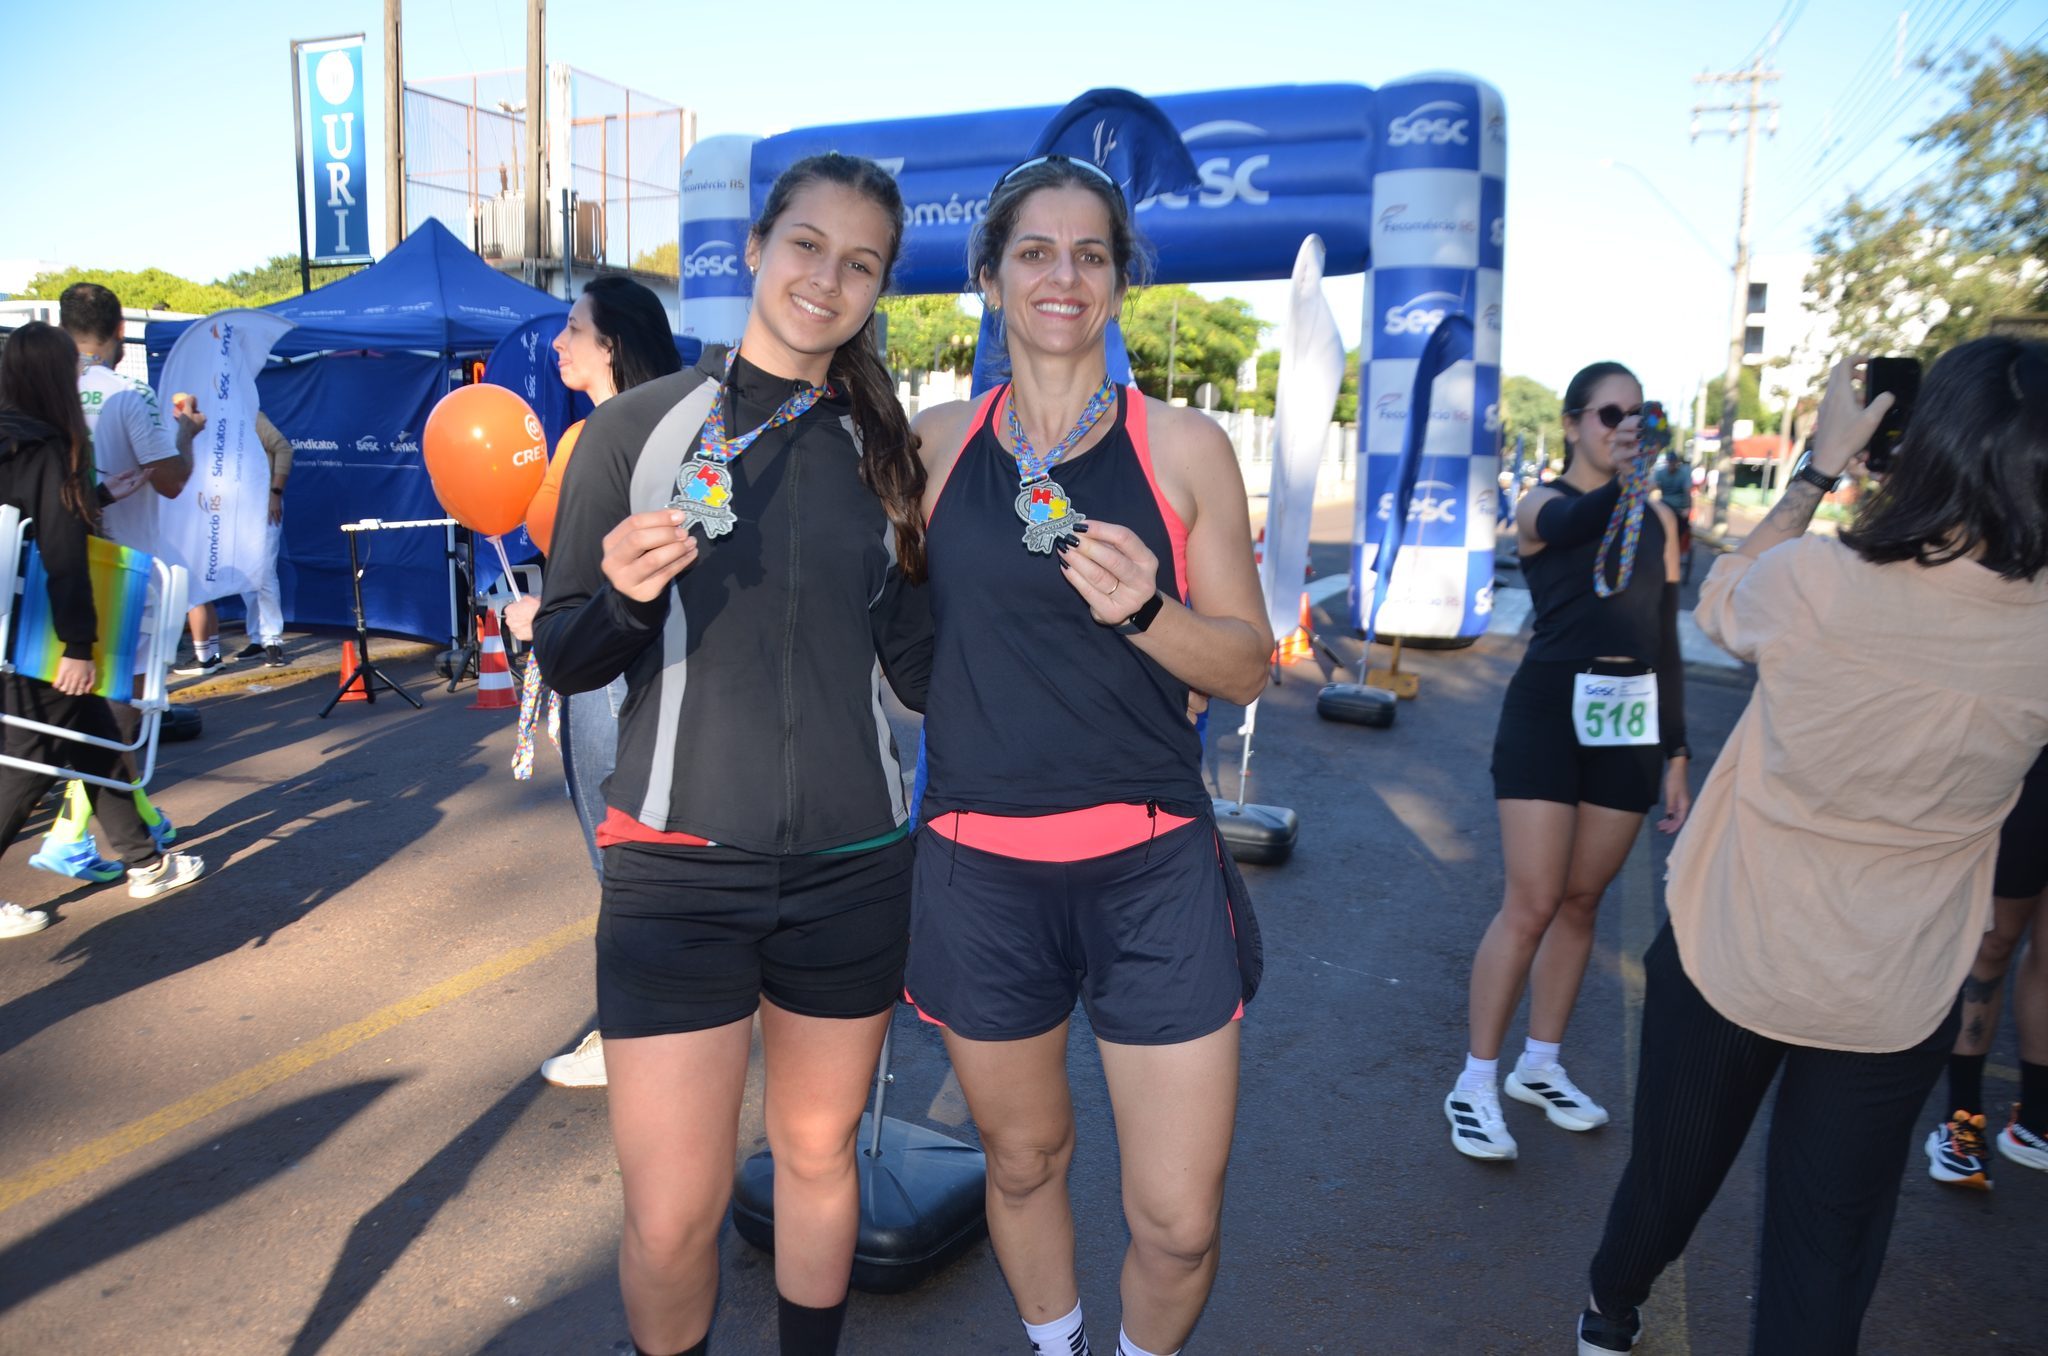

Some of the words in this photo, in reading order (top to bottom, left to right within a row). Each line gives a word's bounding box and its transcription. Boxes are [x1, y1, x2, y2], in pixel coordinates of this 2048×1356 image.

[322, 112, 356, 254] URI
[81, 391, 103, 405] OB
[213, 417, 227, 477] Sindicatos
[291, 438, 339, 450] Sindicatos
[210, 495, 221, 512] RS
[206, 514, 220, 582] Fecomércio
[1585, 702, 1647, 738] 518
